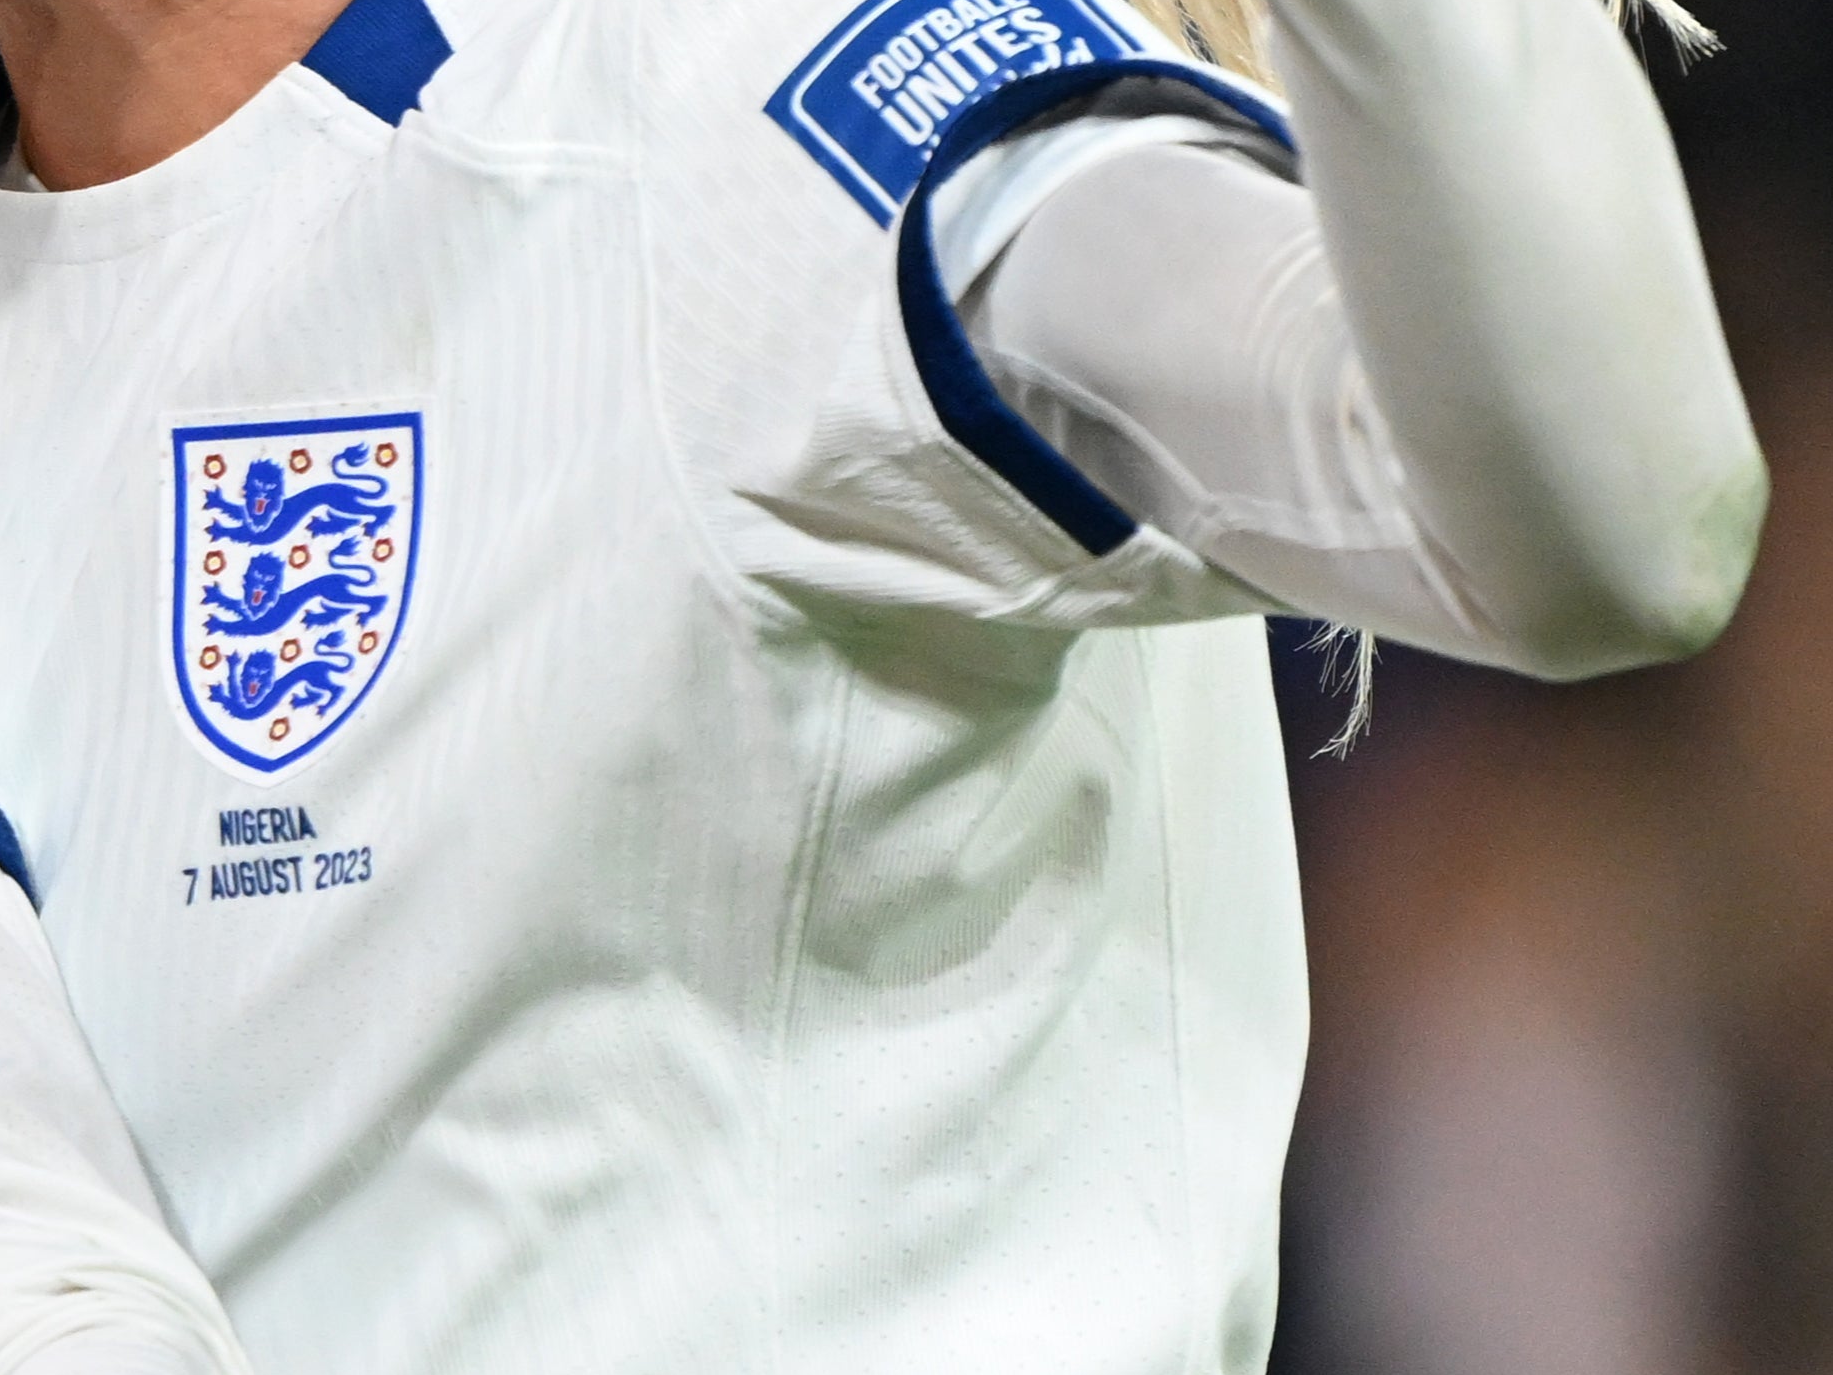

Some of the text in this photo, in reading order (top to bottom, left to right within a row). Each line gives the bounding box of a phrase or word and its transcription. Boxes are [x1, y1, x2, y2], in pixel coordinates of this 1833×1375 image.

[879, 6, 1063, 147] UNITES
[218, 805, 318, 847] NIGERIA
[182, 845, 374, 907] 7 AUGUST 2023
